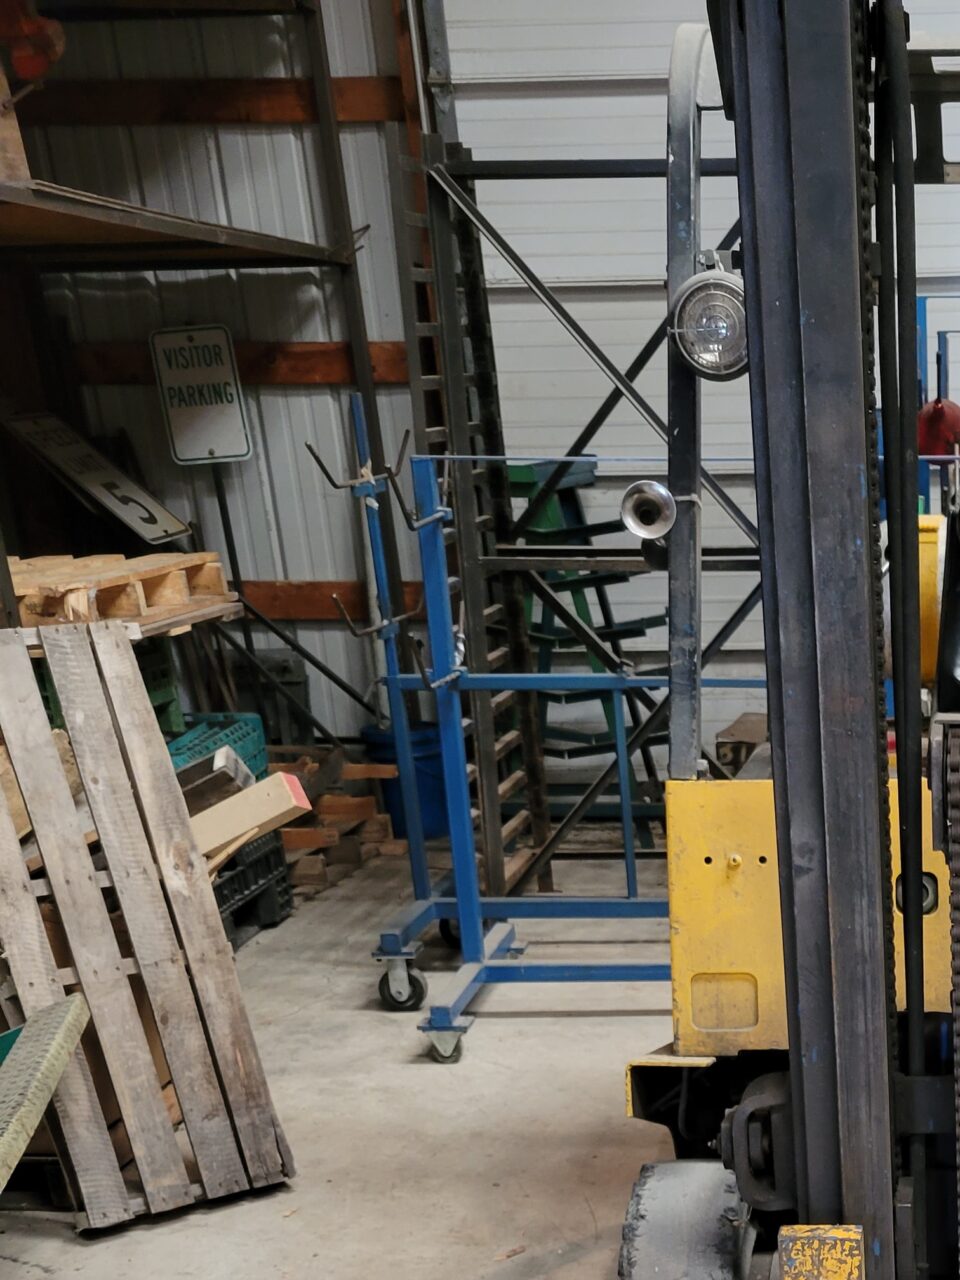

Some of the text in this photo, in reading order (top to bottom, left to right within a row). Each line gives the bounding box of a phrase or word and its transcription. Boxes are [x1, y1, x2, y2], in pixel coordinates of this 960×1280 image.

[162, 344, 224, 369] VISITOR
[167, 382, 234, 408] PARKING
[101, 481, 157, 525] 5
